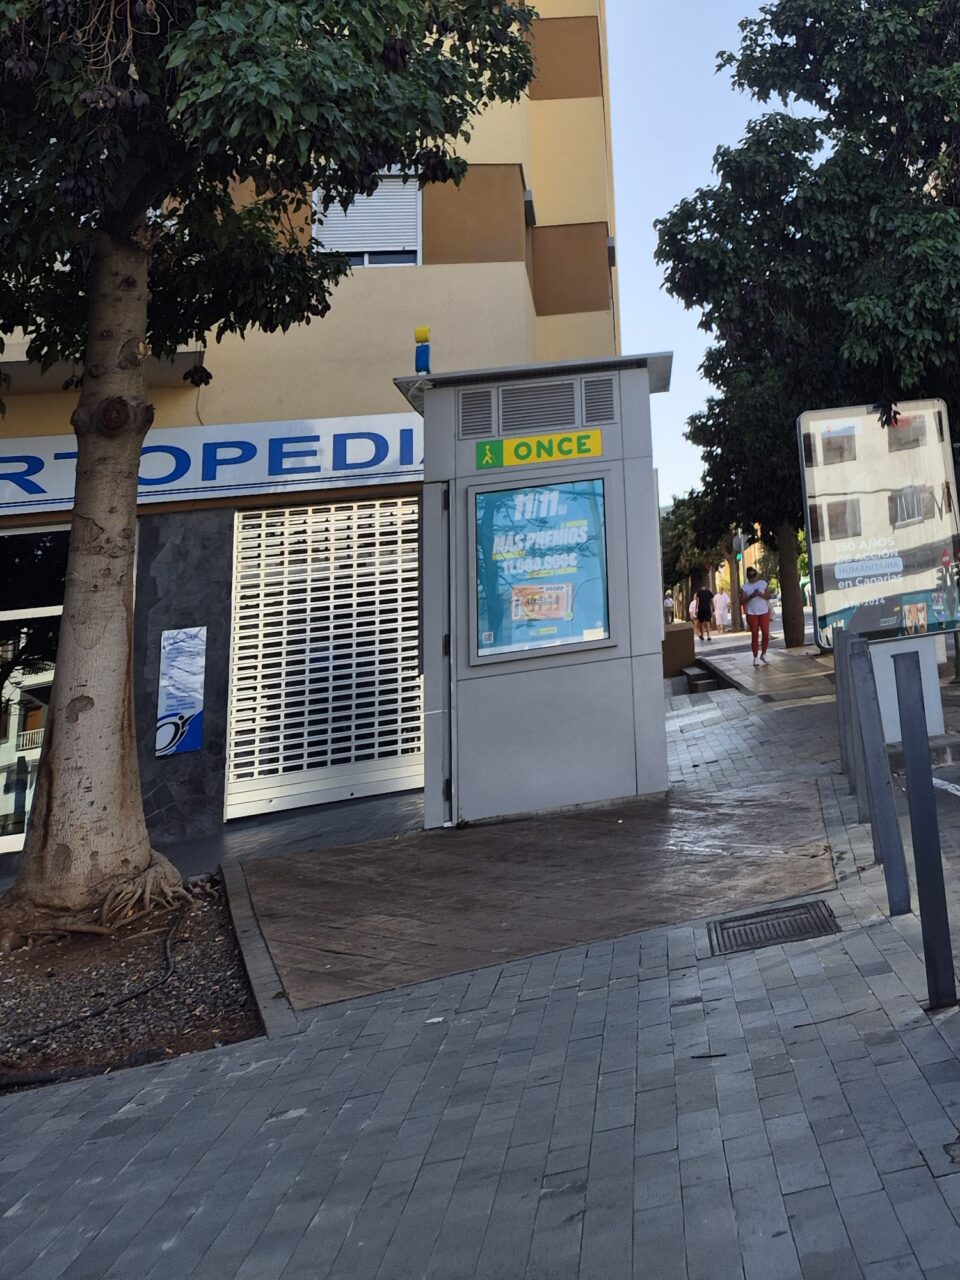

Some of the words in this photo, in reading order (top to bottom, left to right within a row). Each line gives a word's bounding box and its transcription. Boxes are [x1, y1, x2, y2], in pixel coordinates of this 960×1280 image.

[513, 434, 592, 461] ONCE
[0, 428, 424, 495] ROPEDI
[838, 561, 900, 575] HUMANITARIA
[838, 579, 852, 589] en
[855, 573, 903, 586] Canarias
